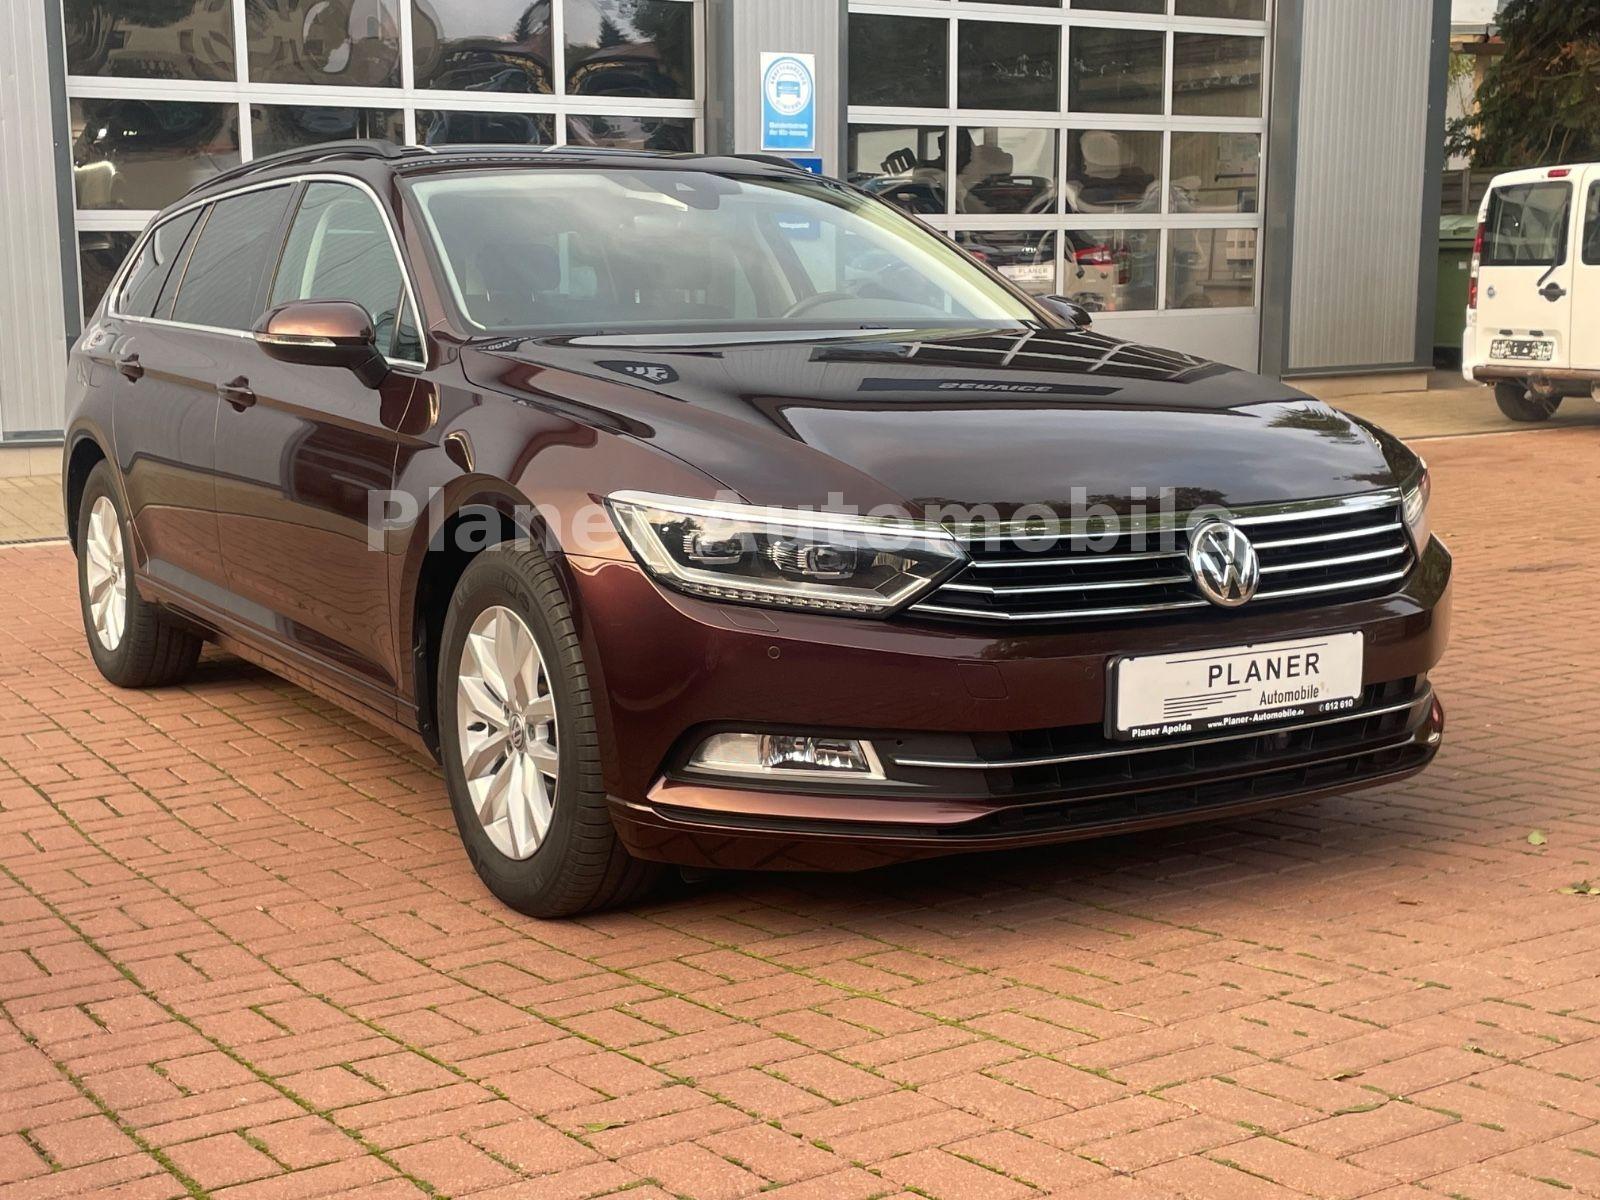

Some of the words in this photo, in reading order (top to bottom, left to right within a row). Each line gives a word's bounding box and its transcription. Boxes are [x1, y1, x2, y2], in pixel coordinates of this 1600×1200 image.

[1208, 653, 1320, 687] PLANER
[1259, 685, 1319, 706] Automobile
[1325, 700, 1339, 711] 612
[1131, 727, 1160, 738] Planer
